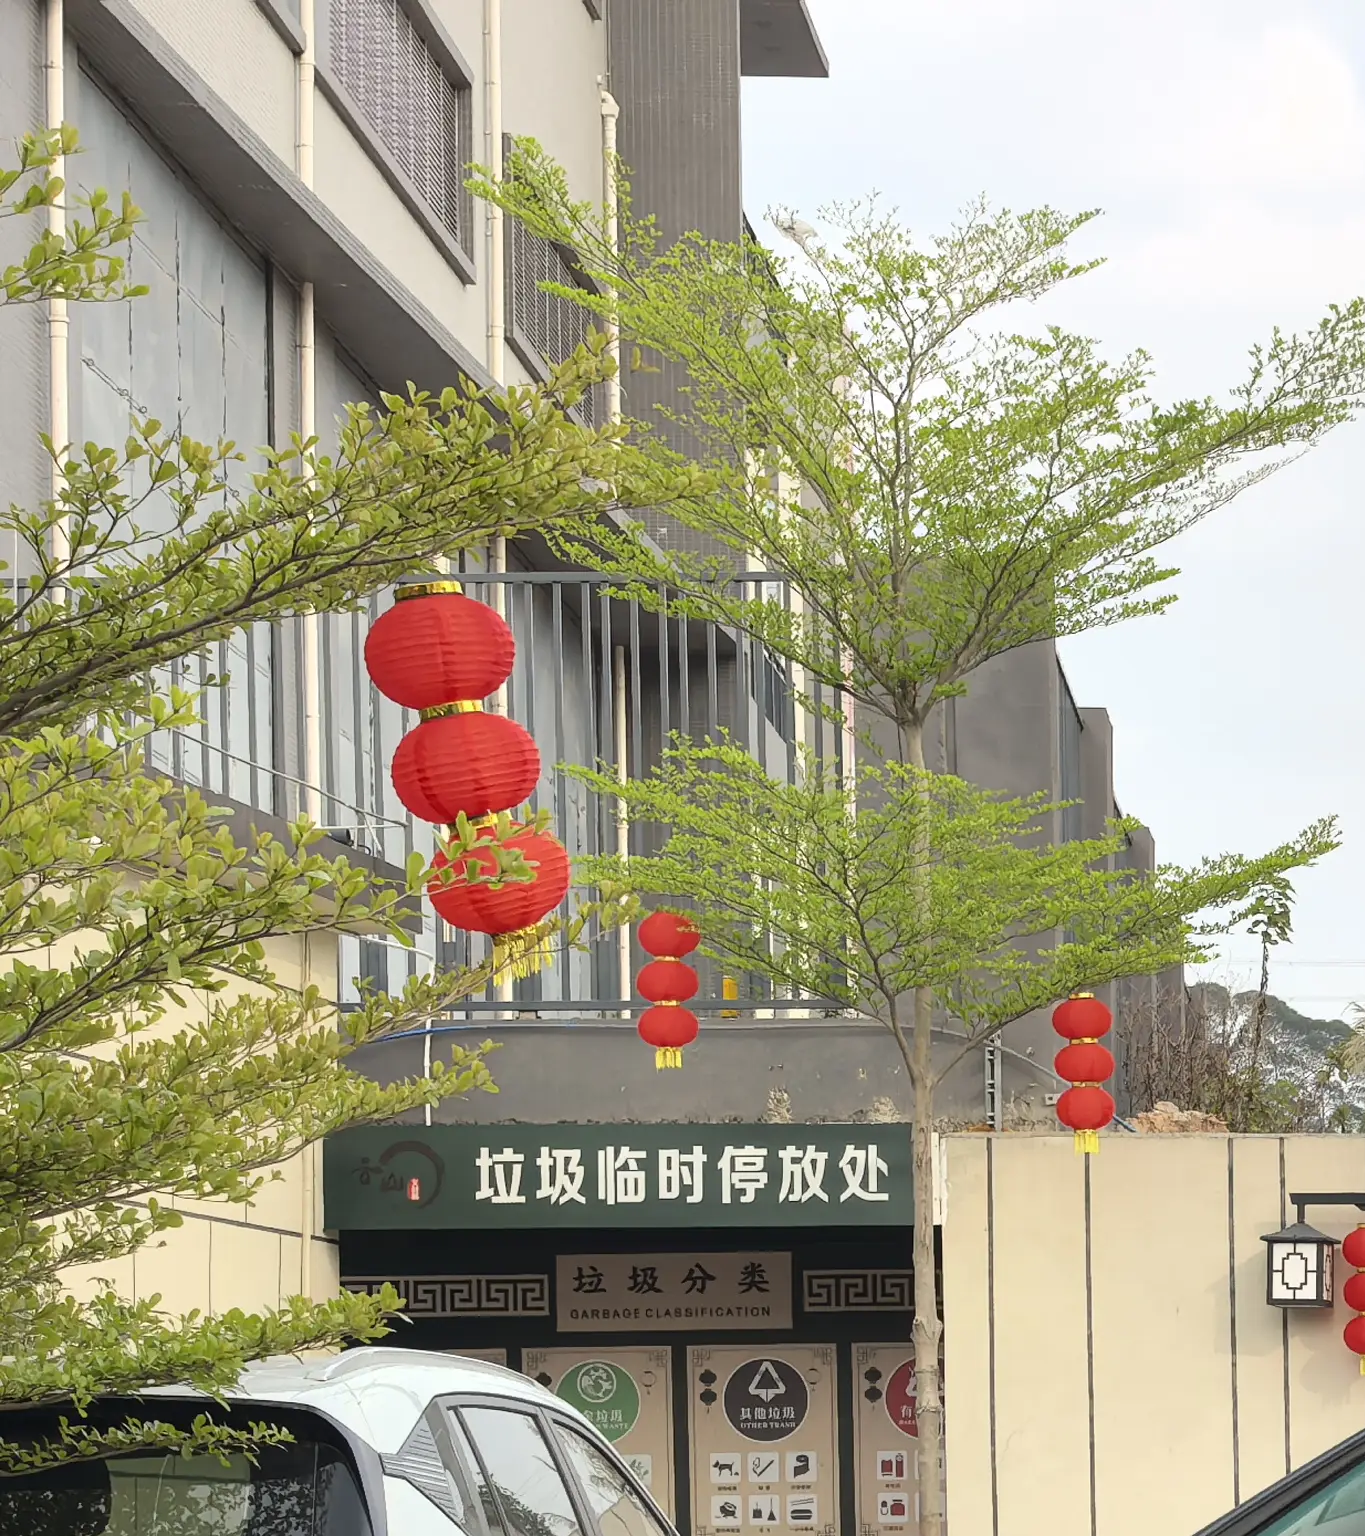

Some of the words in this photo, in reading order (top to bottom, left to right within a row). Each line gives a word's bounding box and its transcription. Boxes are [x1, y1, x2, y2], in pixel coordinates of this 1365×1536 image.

[475, 1145, 890, 1205] 垃圾临时停放处
[572, 1262, 770, 1294] 垃圾分类
[570, 1308, 640, 1319] GARBAGE
[645, 1306, 771, 1318] CLASSIFICATION
[740, 1407, 796, 1420] 其他垃圾
